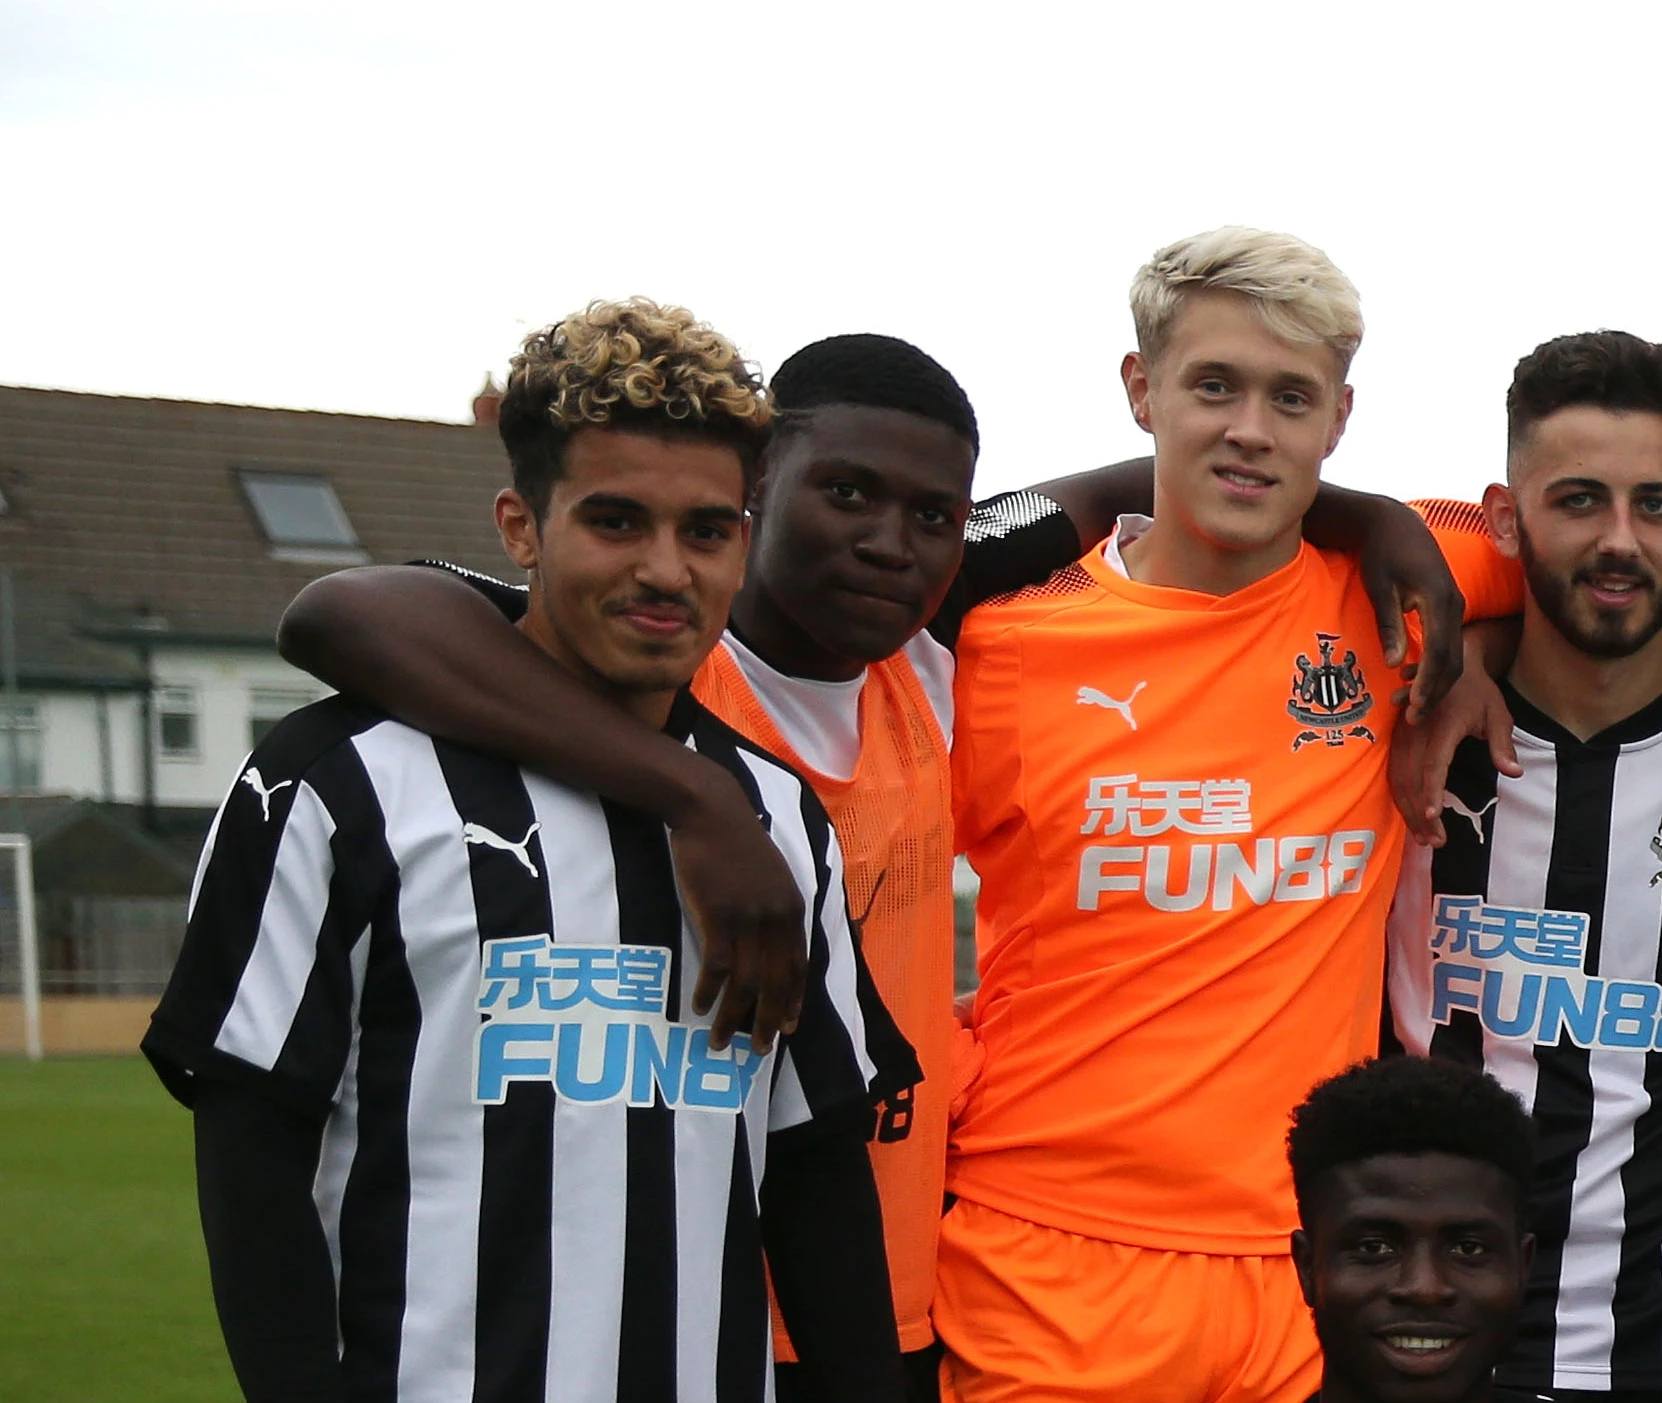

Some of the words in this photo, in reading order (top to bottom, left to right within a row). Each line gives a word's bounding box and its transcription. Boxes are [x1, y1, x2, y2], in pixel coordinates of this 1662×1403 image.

[1300, 712, 1338, 724] NEWCASTLE
[1339, 708, 1363, 722] UNITED
[1326, 730, 1344, 740] 125
[1080, 774, 1252, 836] 乐天堂
[1077, 830, 1376, 912] FUN88
[1431, 896, 1585, 968] 乐天堂
[479, 938, 666, 1013] 乐天堂
